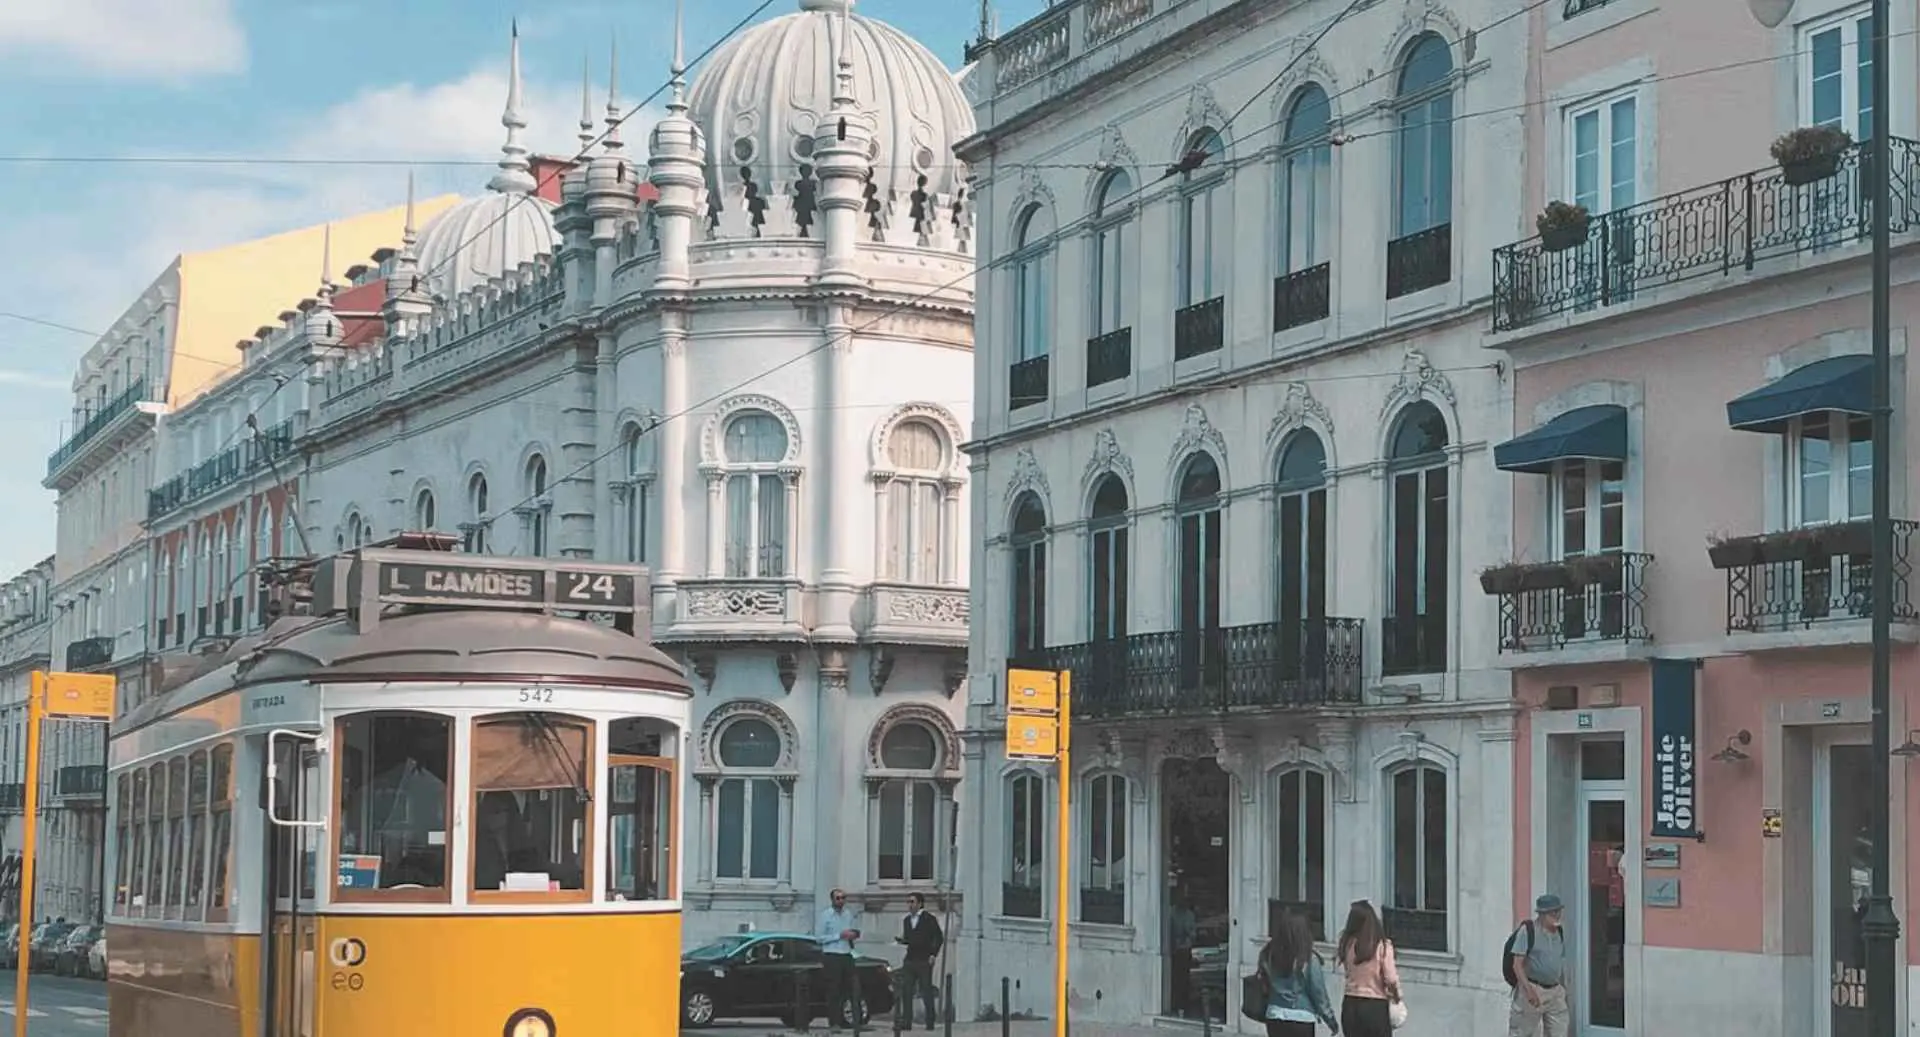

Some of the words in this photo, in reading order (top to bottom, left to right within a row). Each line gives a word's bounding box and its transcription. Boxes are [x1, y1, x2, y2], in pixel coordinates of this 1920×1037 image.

[391, 567, 410, 590] L
[425, 569, 532, 596] CAMÕES
[568, 574, 615, 600] 24
[519, 688, 553, 703] 542
[1657, 734, 1675, 829] Jamie
[1675, 735, 1693, 830] Oliver
[1832, 961, 1866, 984] Ja
[1832, 984, 1864, 1007] Oli
